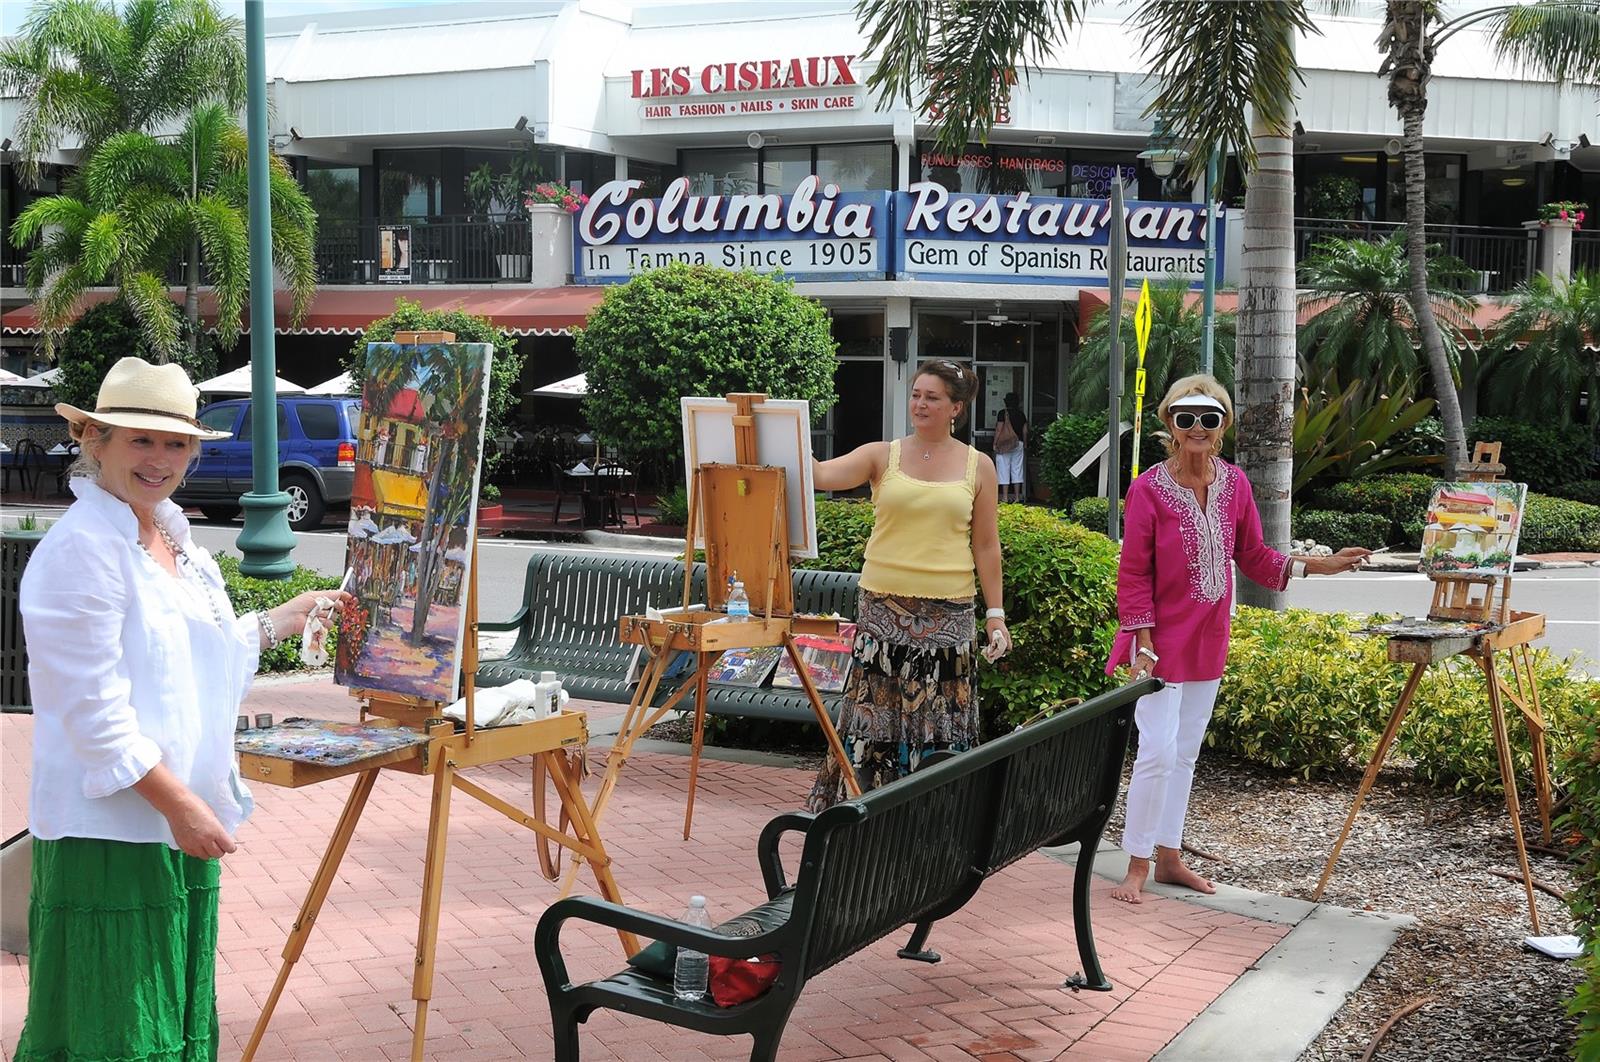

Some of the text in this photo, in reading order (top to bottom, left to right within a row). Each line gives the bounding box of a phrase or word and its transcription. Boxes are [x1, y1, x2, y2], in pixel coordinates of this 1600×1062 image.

[631, 54, 857, 98] LES CISEAUX
[645, 96, 855, 117] HAIR FASHION NAILS SKIN CARE
[1000, 156, 1065, 173] HANDBAGS
[1071, 164, 1136, 179] DESIGNER
[1086, 178, 1115, 193] COP
[579, 175, 875, 245] Columbia
[589, 242, 872, 270] In Tampa Since 1905
[908, 241, 1205, 274] Gem of Spanish Rtaurants
